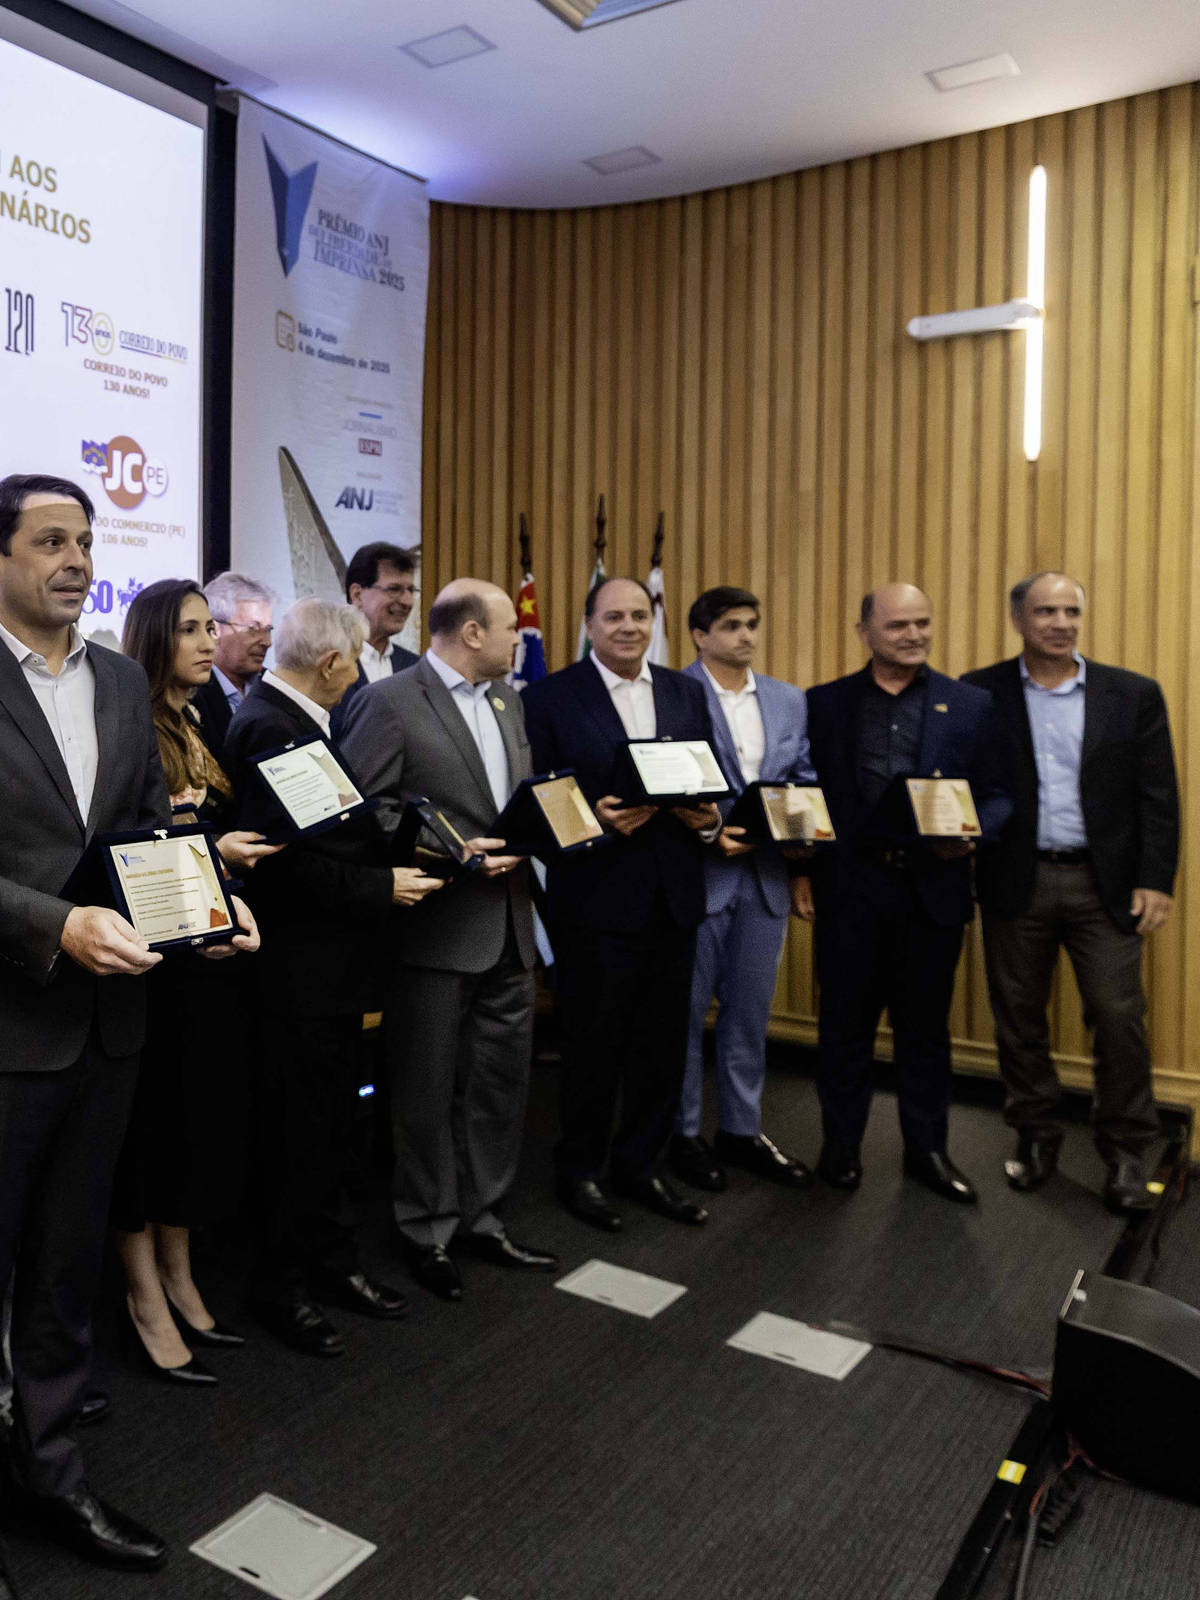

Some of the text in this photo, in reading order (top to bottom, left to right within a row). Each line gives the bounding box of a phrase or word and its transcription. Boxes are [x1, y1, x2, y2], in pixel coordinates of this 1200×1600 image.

[9, 155, 57, 192] AOS
[83, 358, 168, 387] CORREIO DO POVO
[104, 380, 150, 399] 130 ANOS!
[105, 450, 163, 494] JC PE
[335, 486, 374, 511] ANJ
[112, 518, 166, 533] COMMERCIO
[168, 525, 186, 538] (PE)
[121, 535, 148, 547] ANOS!
